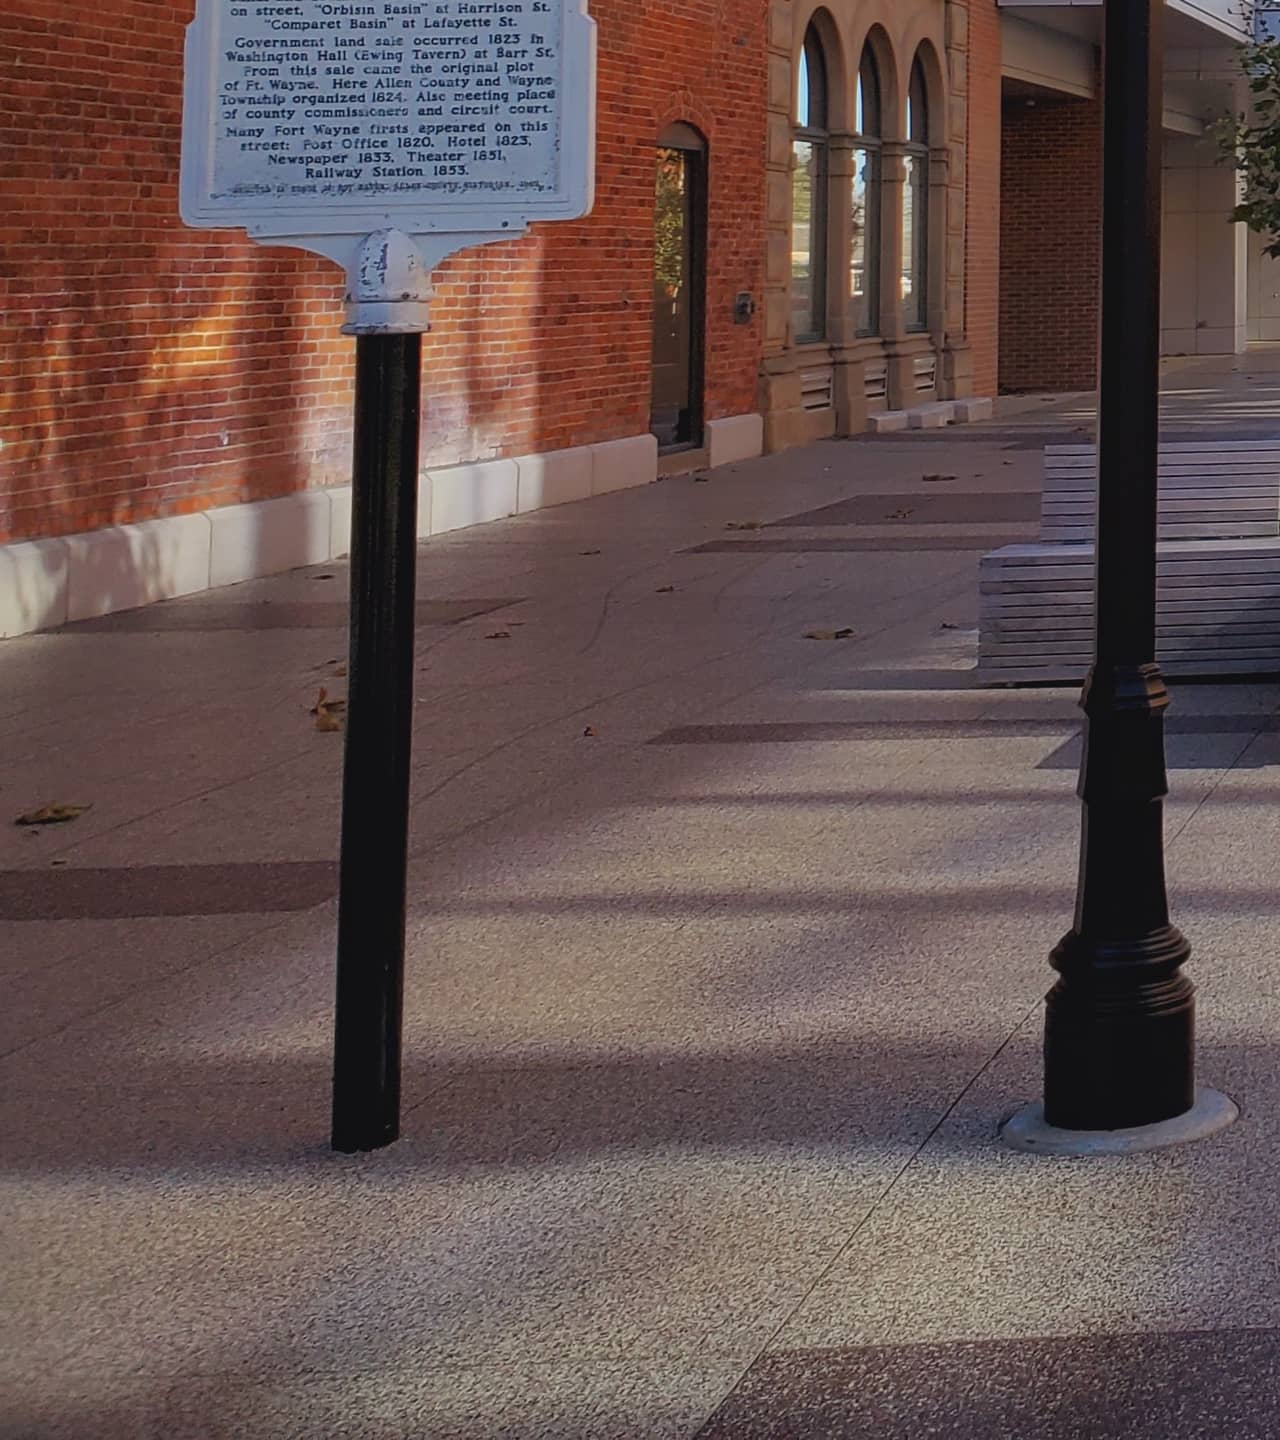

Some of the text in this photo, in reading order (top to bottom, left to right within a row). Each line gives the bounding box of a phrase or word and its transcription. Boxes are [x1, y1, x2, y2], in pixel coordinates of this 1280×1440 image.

[230, 7, 248, 16] on
[435, 3, 449, 14] at
[458, 2, 523, 13] Harrison
[532, 2, 551, 13] St.
[402, 17, 416, 28] at
[424, 16, 492, 30] Lafayette
[498, 16, 518, 27] St.
[234, 33, 544, 47] Government land occurred 1823 in
[317, 49, 347, 60] Hall
[411, 48, 466, 59] Tavern)
[473, 47, 488, 58] at
[496, 47, 529, 58] Barr
[290, 64, 317, 75] this
[324, 64, 355, 75] sale
[410, 63, 432, 74] the
[441, 62, 498, 76] original
[506, 61, 535, 75] plot
[224, 80, 240, 91] of
[332, 78, 368, 89] Here
[475, 75, 501, 86] and
[292, 92, 366, 106] organized
[453, 89, 509, 103] meeting
[245, 103, 553, 121] county and court.
[271, 125, 305, 136] Fort
[312, 124, 364, 138] Wayne
[418, 122, 486, 136] appeared
[494, 123, 512, 132] on
[520, 120, 549, 131] this
[341, 137, 388, 148] Office
[447, 136, 486, 147] Hotel
[268, 152, 348, 166] Newspaper
[406, 150, 467, 161] Theater
[305, 164, 470, 180] Railway Station 1853.
